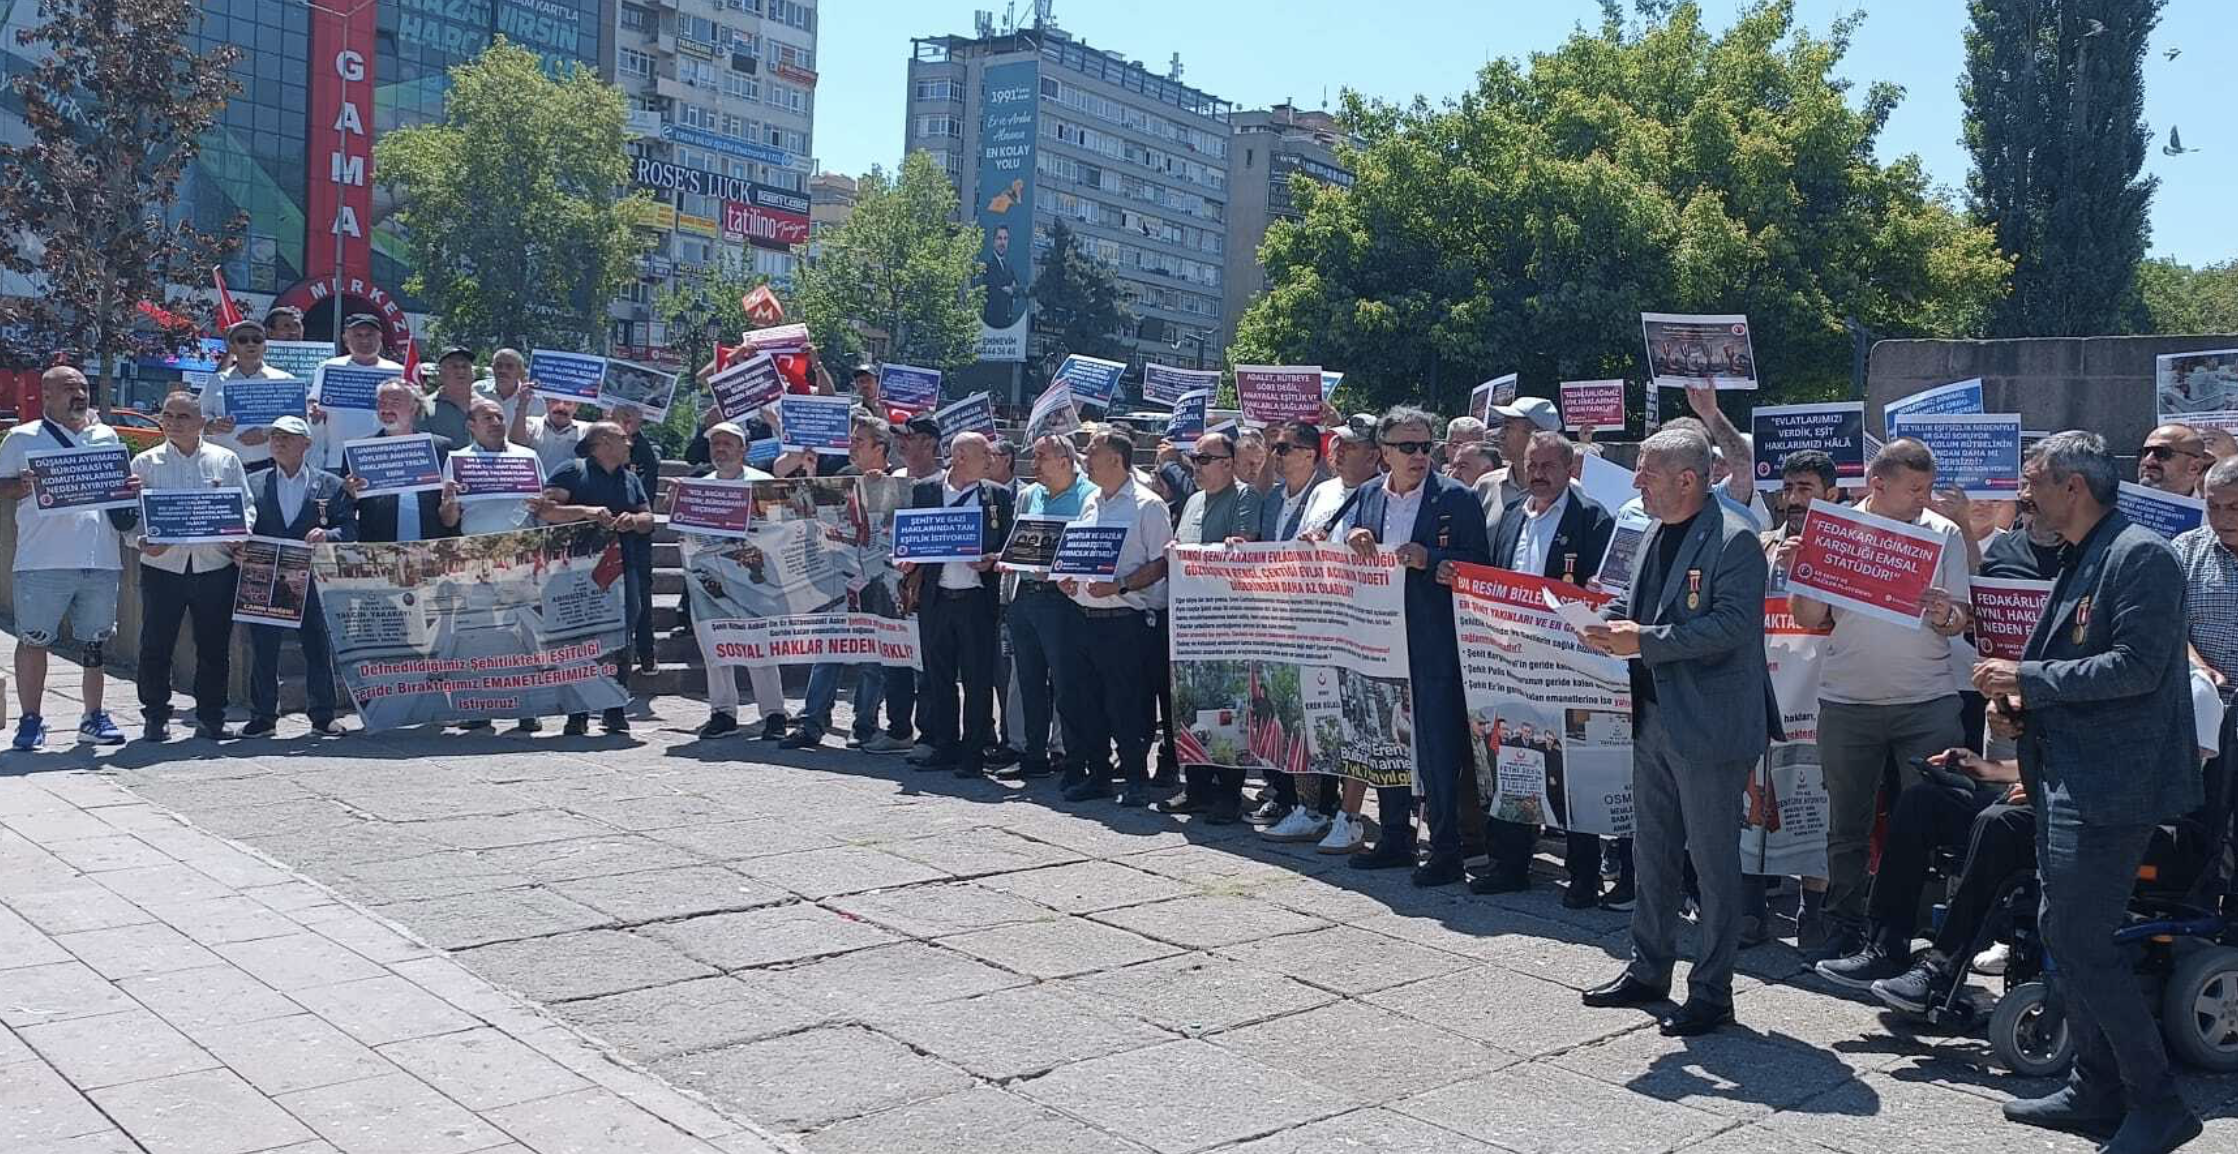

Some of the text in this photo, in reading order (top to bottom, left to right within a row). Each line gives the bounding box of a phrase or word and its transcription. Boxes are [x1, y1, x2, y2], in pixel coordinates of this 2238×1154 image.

[991, 89, 1016, 103] 1991
[331, 50, 364, 238] GAMA
[986, 144, 1031, 158] EN KOLAY
[995, 157, 1021, 171] YOLU
[636, 157, 752, 206] ROSE'S LUCK
[727, 206, 776, 239] tatilino
[1256, 382, 1276, 391] GÖRE
[1242, 392, 1279, 401] ANAYASAL
[1280, 391, 1307, 402] EŞİTLİK
[1814, 425, 1834, 438] EŞİT
[1764, 439, 1822, 451] HAKLARIMIZI
[1931, 440, 1959, 448] KOLUM
[1931, 449, 1961, 457] UNDAN
[1961, 449, 1986, 457] DAHA
[103, 460, 115, 470] VE
[46, 484, 79, 494] NEDEN
[910, 514, 967, 526] ŞEHİT VE GAZİ
[901, 523, 976, 534] HAKLARINDA TAM
[900, 534, 930, 545] EŞİTLİK
[1202, 549, 1229, 564] ŞEHİT
[1815, 535, 1919, 574] KARŞILIĞI EMSAL
[1262, 564, 1299, 581] ÇEKTİĞİ
[1299, 565, 1325, 579] EVLAT
[1282, 581, 1304, 594] DAHA
[1305, 581, 1318, 594] AZ
[1472, 577, 1508, 599] RESİM
[1490, 606, 1533, 625] YAKINLARI
[1535, 616, 1548, 628] VE
[1549, 619, 1562, 631] ER
[1975, 606, 2005, 621] AYNI,
[1765, 612, 1801, 630] AKTA
[1983, 621, 2023, 635] NEDEN
[716, 638, 877, 659] SOSYAL HAKLAR NEDEN
[1552, 638, 1577, 651] sağlık
[469, 654, 547, 672] Şehitlikteki
[1528, 660, 1555, 671] geride
[483, 664, 598, 689] EMANETLERİMİZE
[601, 664, 618, 676] de
[1468, 664, 1594, 688] Şehit Polis geride kalan
[1545, 694, 1599, 705] emanetlerine
[1599, 695, 1612, 705] ise
[1372, 742, 1403, 757] Eren
